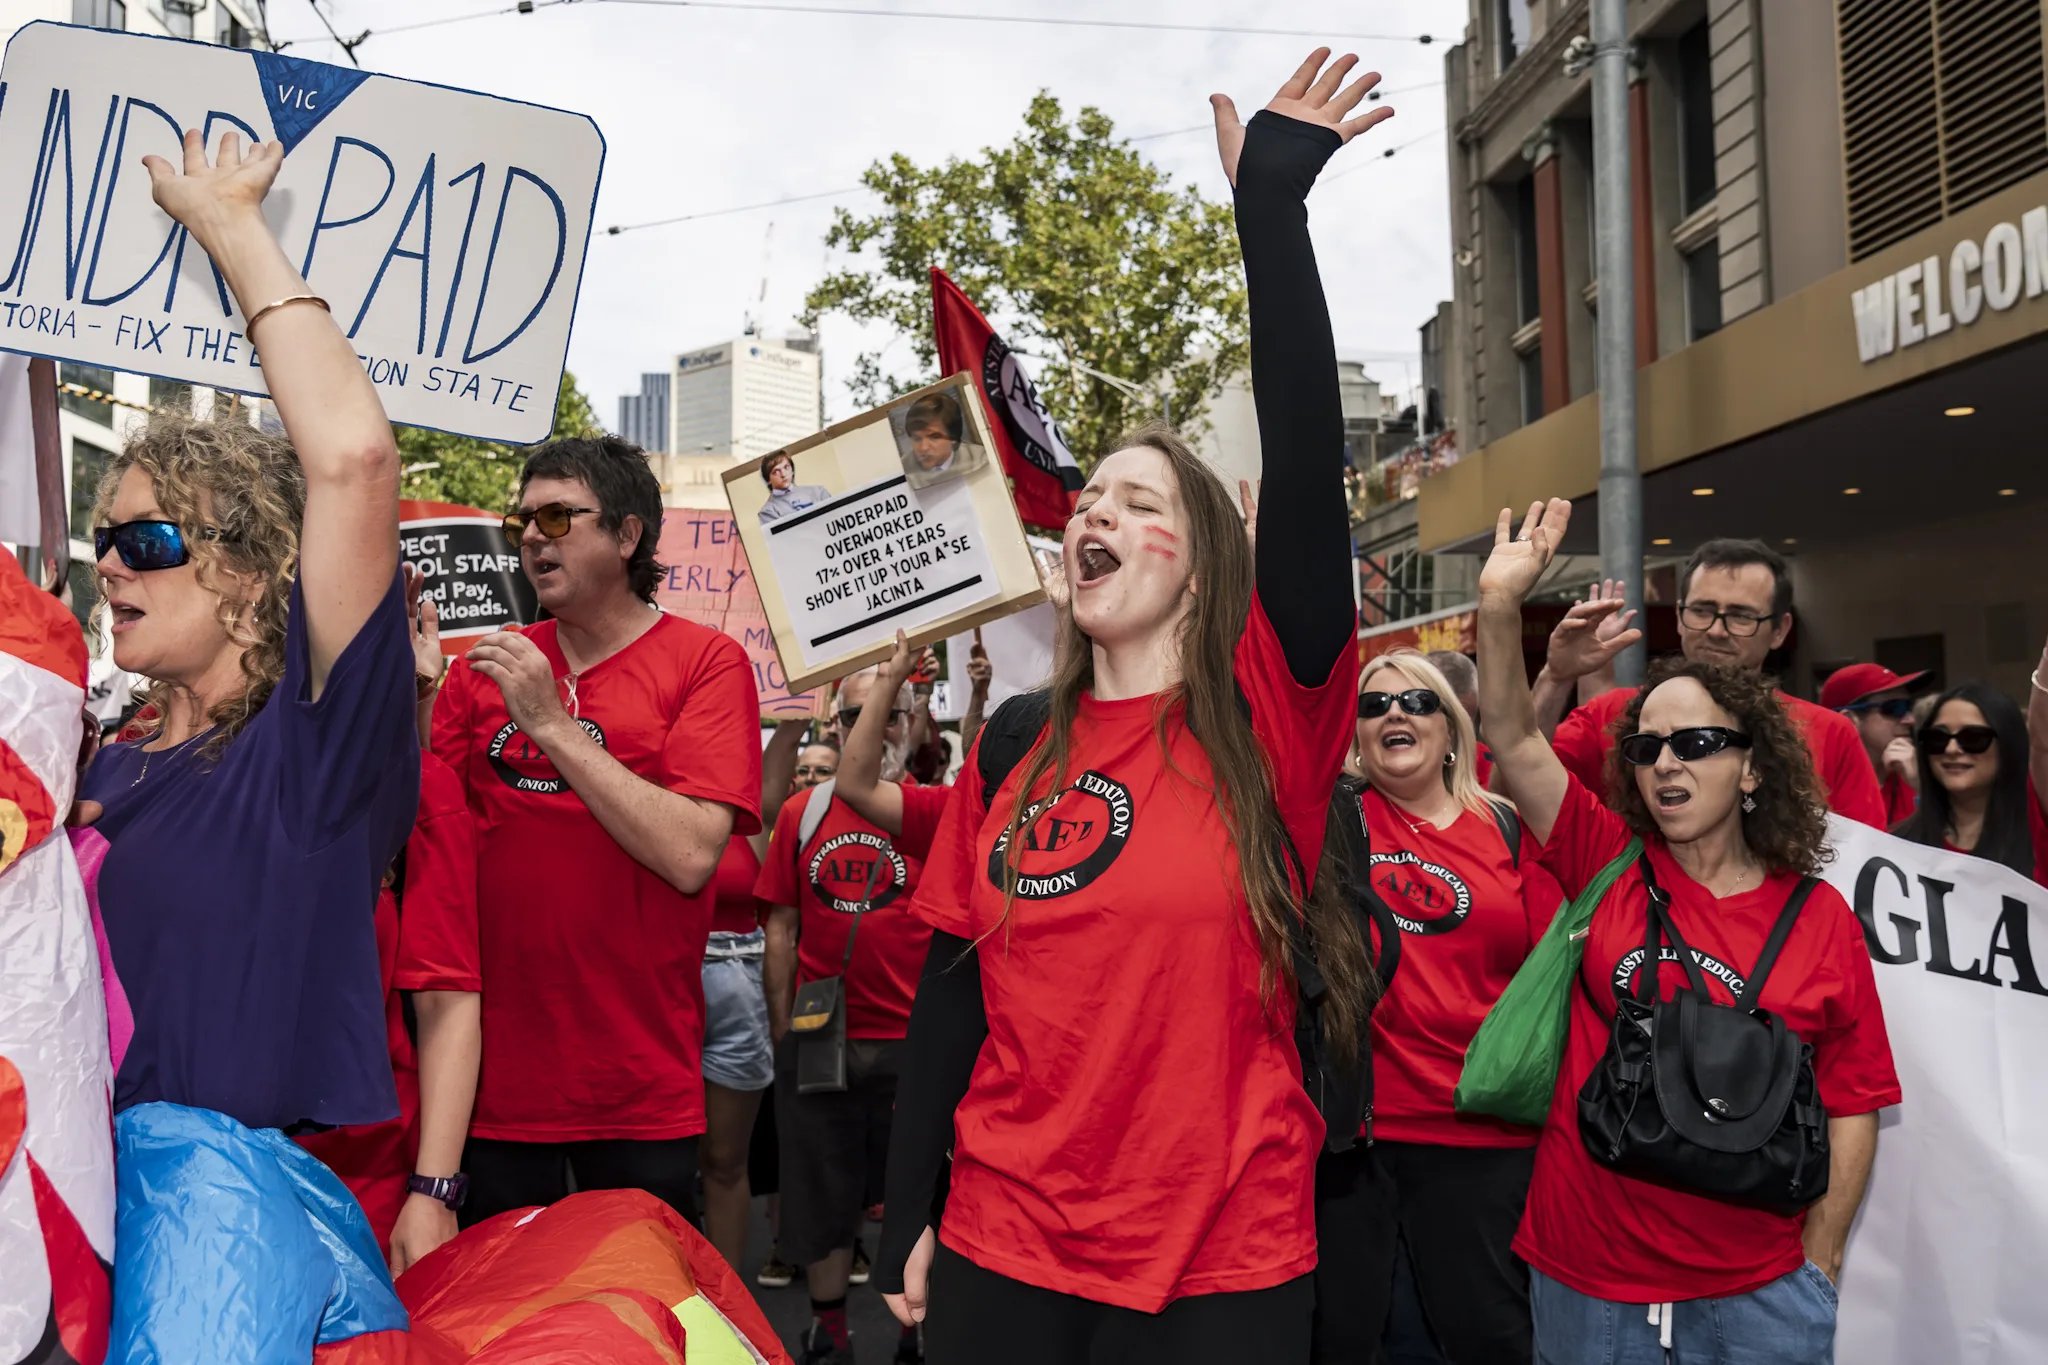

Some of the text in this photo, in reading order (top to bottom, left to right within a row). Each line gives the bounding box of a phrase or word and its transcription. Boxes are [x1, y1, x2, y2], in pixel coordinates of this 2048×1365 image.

[278, 84, 318, 110] VIC
[0, 302, 76, 338] TORIA
[115, 314, 171, 354] FIX
[183, 325, 243, 364] THE
[422, 366, 534, 412] STATE
[826, 493, 909, 538] UNDERPAID
[687, 519, 739, 549] TEA
[824, 509, 924, 560] OVERWORKED
[454, 553, 520, 573] STAFF
[815, 522, 946, 585] 17% OVER 4 YEARS
[452, 580, 493, 601] Pay.
[668, 564, 746, 594] ERLY
[805, 580, 854, 611] SHOVE
[854, 575, 867, 593] IT
[868, 567, 888, 586] UP
[890, 550, 932, 577] YOUR
[865, 577, 925, 611] JACINTA
[436, 598, 508, 621] kloads.
[516, 776, 559, 792] UNION
[808, 832, 906, 886] AUSTRALIAN EDUATION
[1016, 871, 1078, 896] UNION
[1369, 852, 1470, 918] STRALIAN EDUCATION
[1377, 871, 1446, 909] AEU
[1391, 912, 1424, 933] NION
[1853, 855, 2048, 998] GLA
